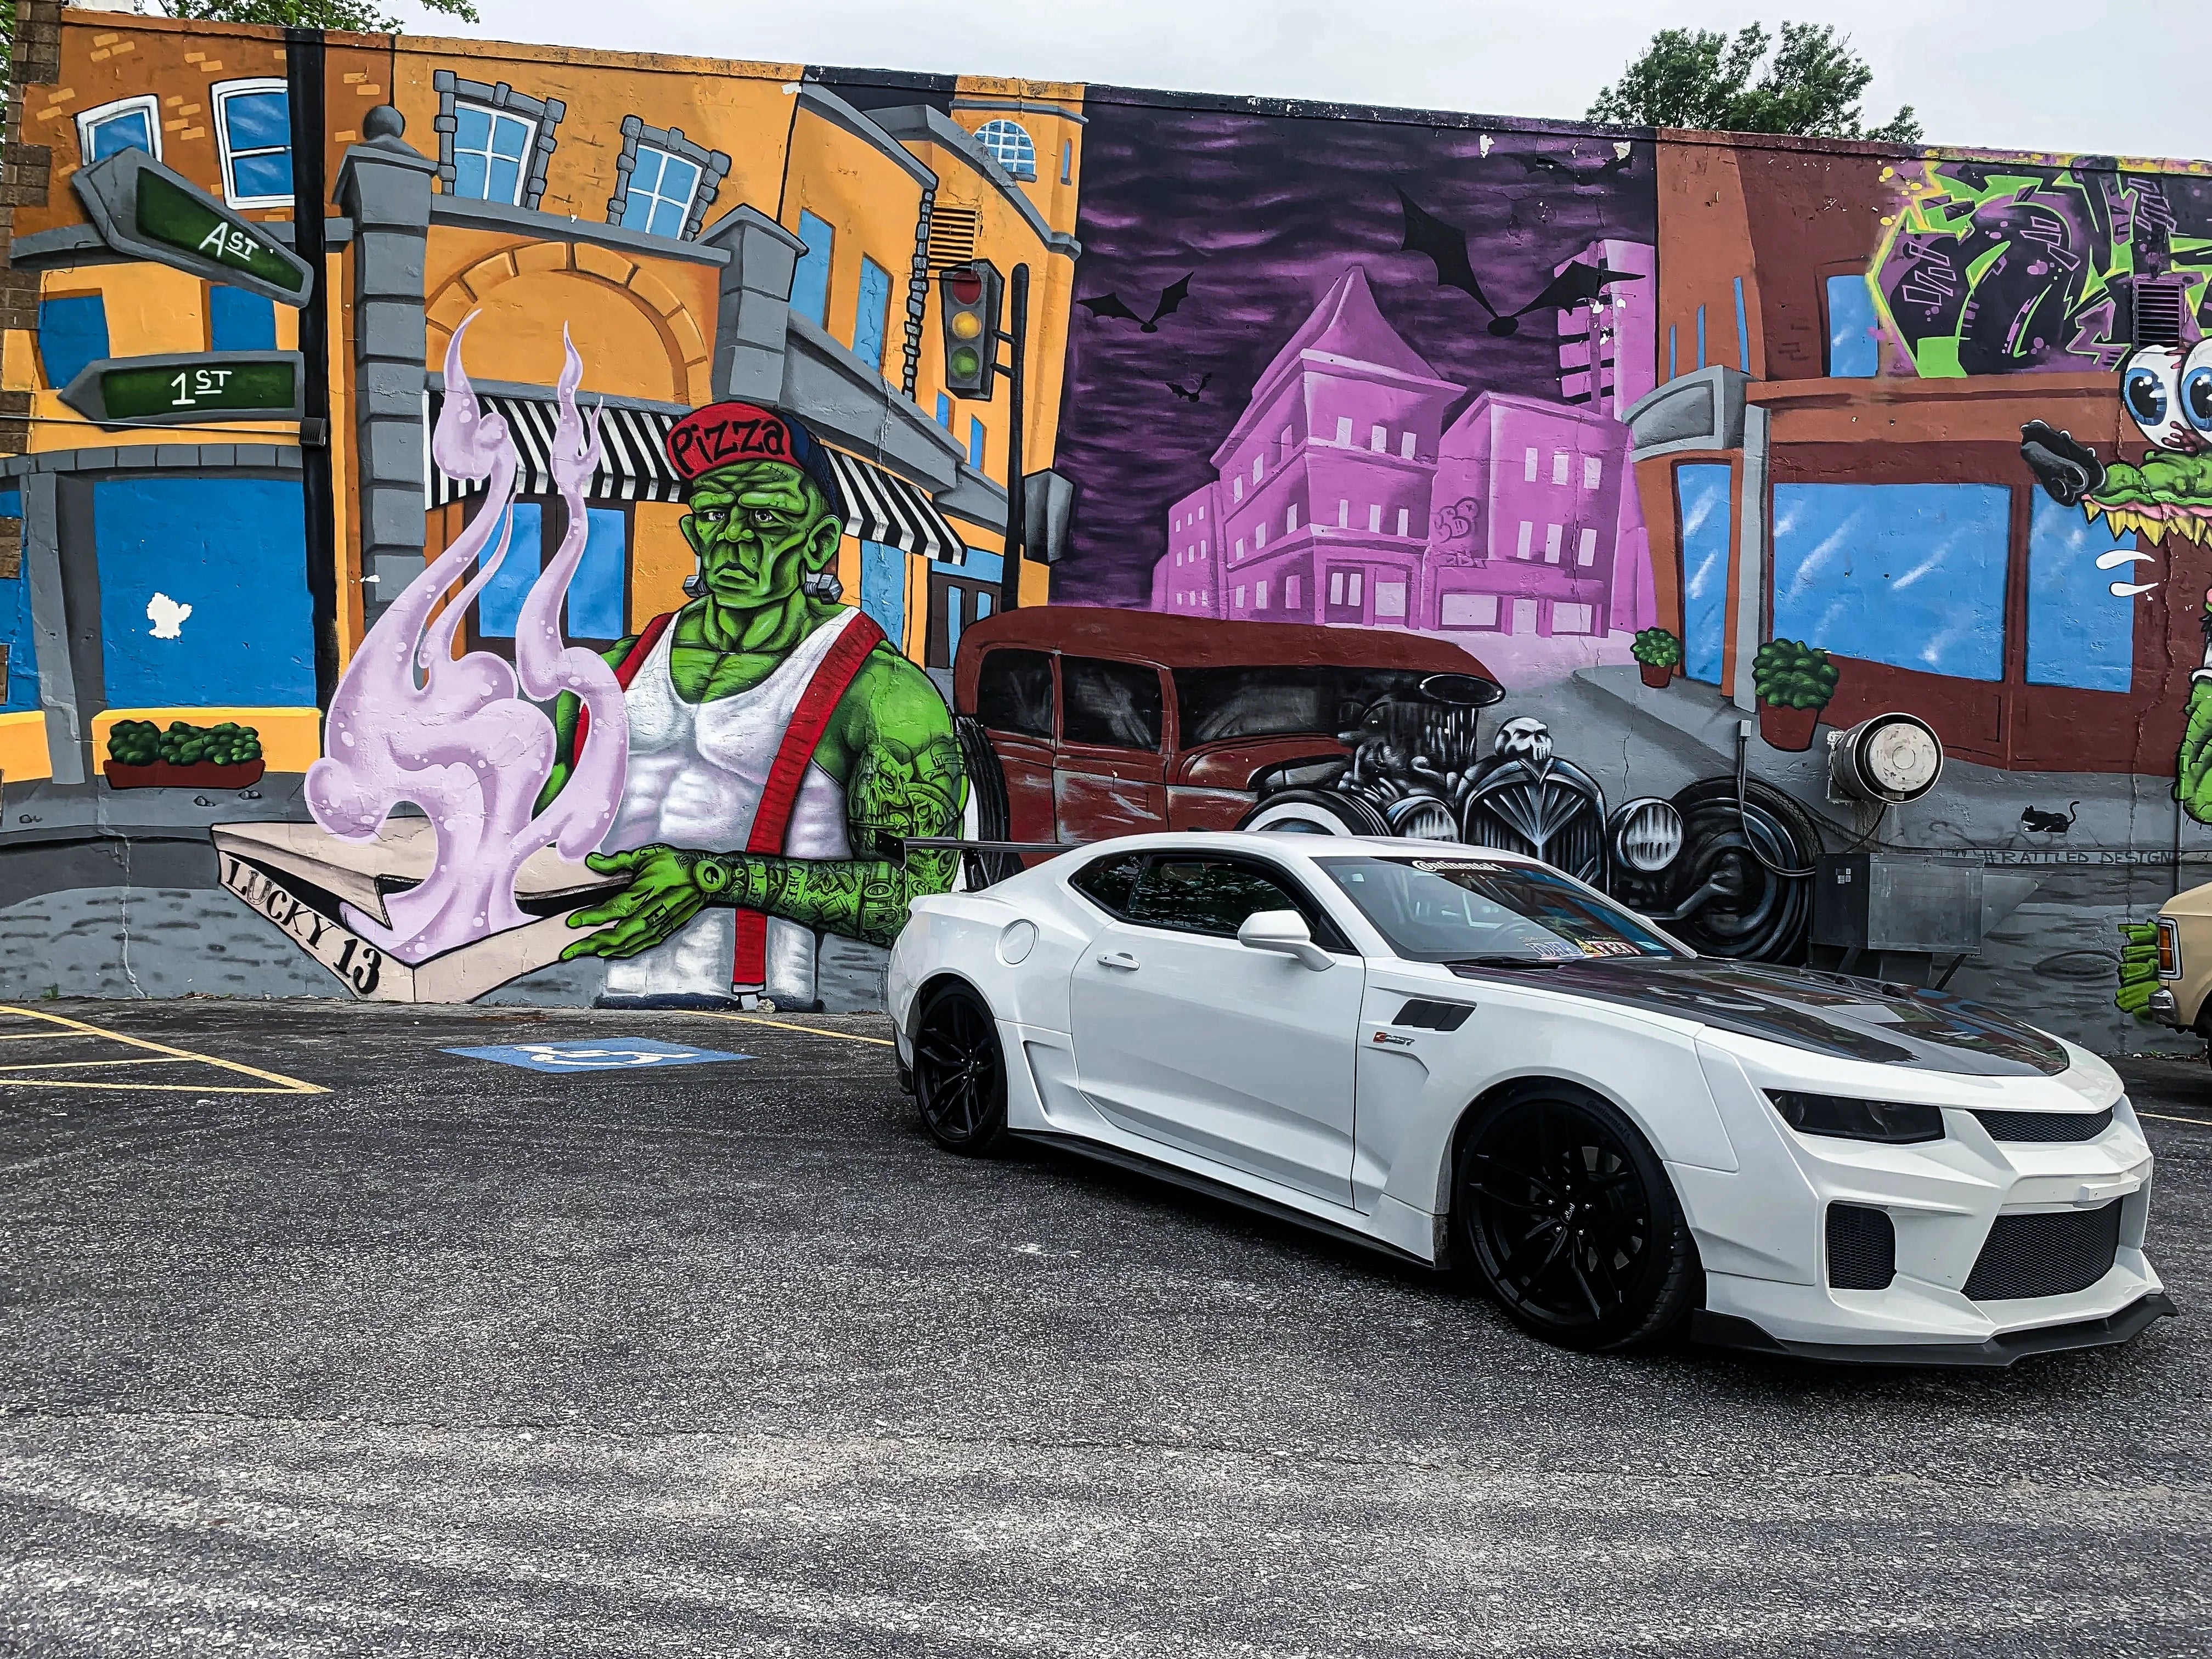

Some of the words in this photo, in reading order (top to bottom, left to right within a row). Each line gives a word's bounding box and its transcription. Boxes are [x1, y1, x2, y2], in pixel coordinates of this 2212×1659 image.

[171, 370, 232, 405] 1ST
[1412, 860, 1499, 872] Continental
[225, 858, 341, 950] LUCKY
[333, 938, 382, 994] 13
